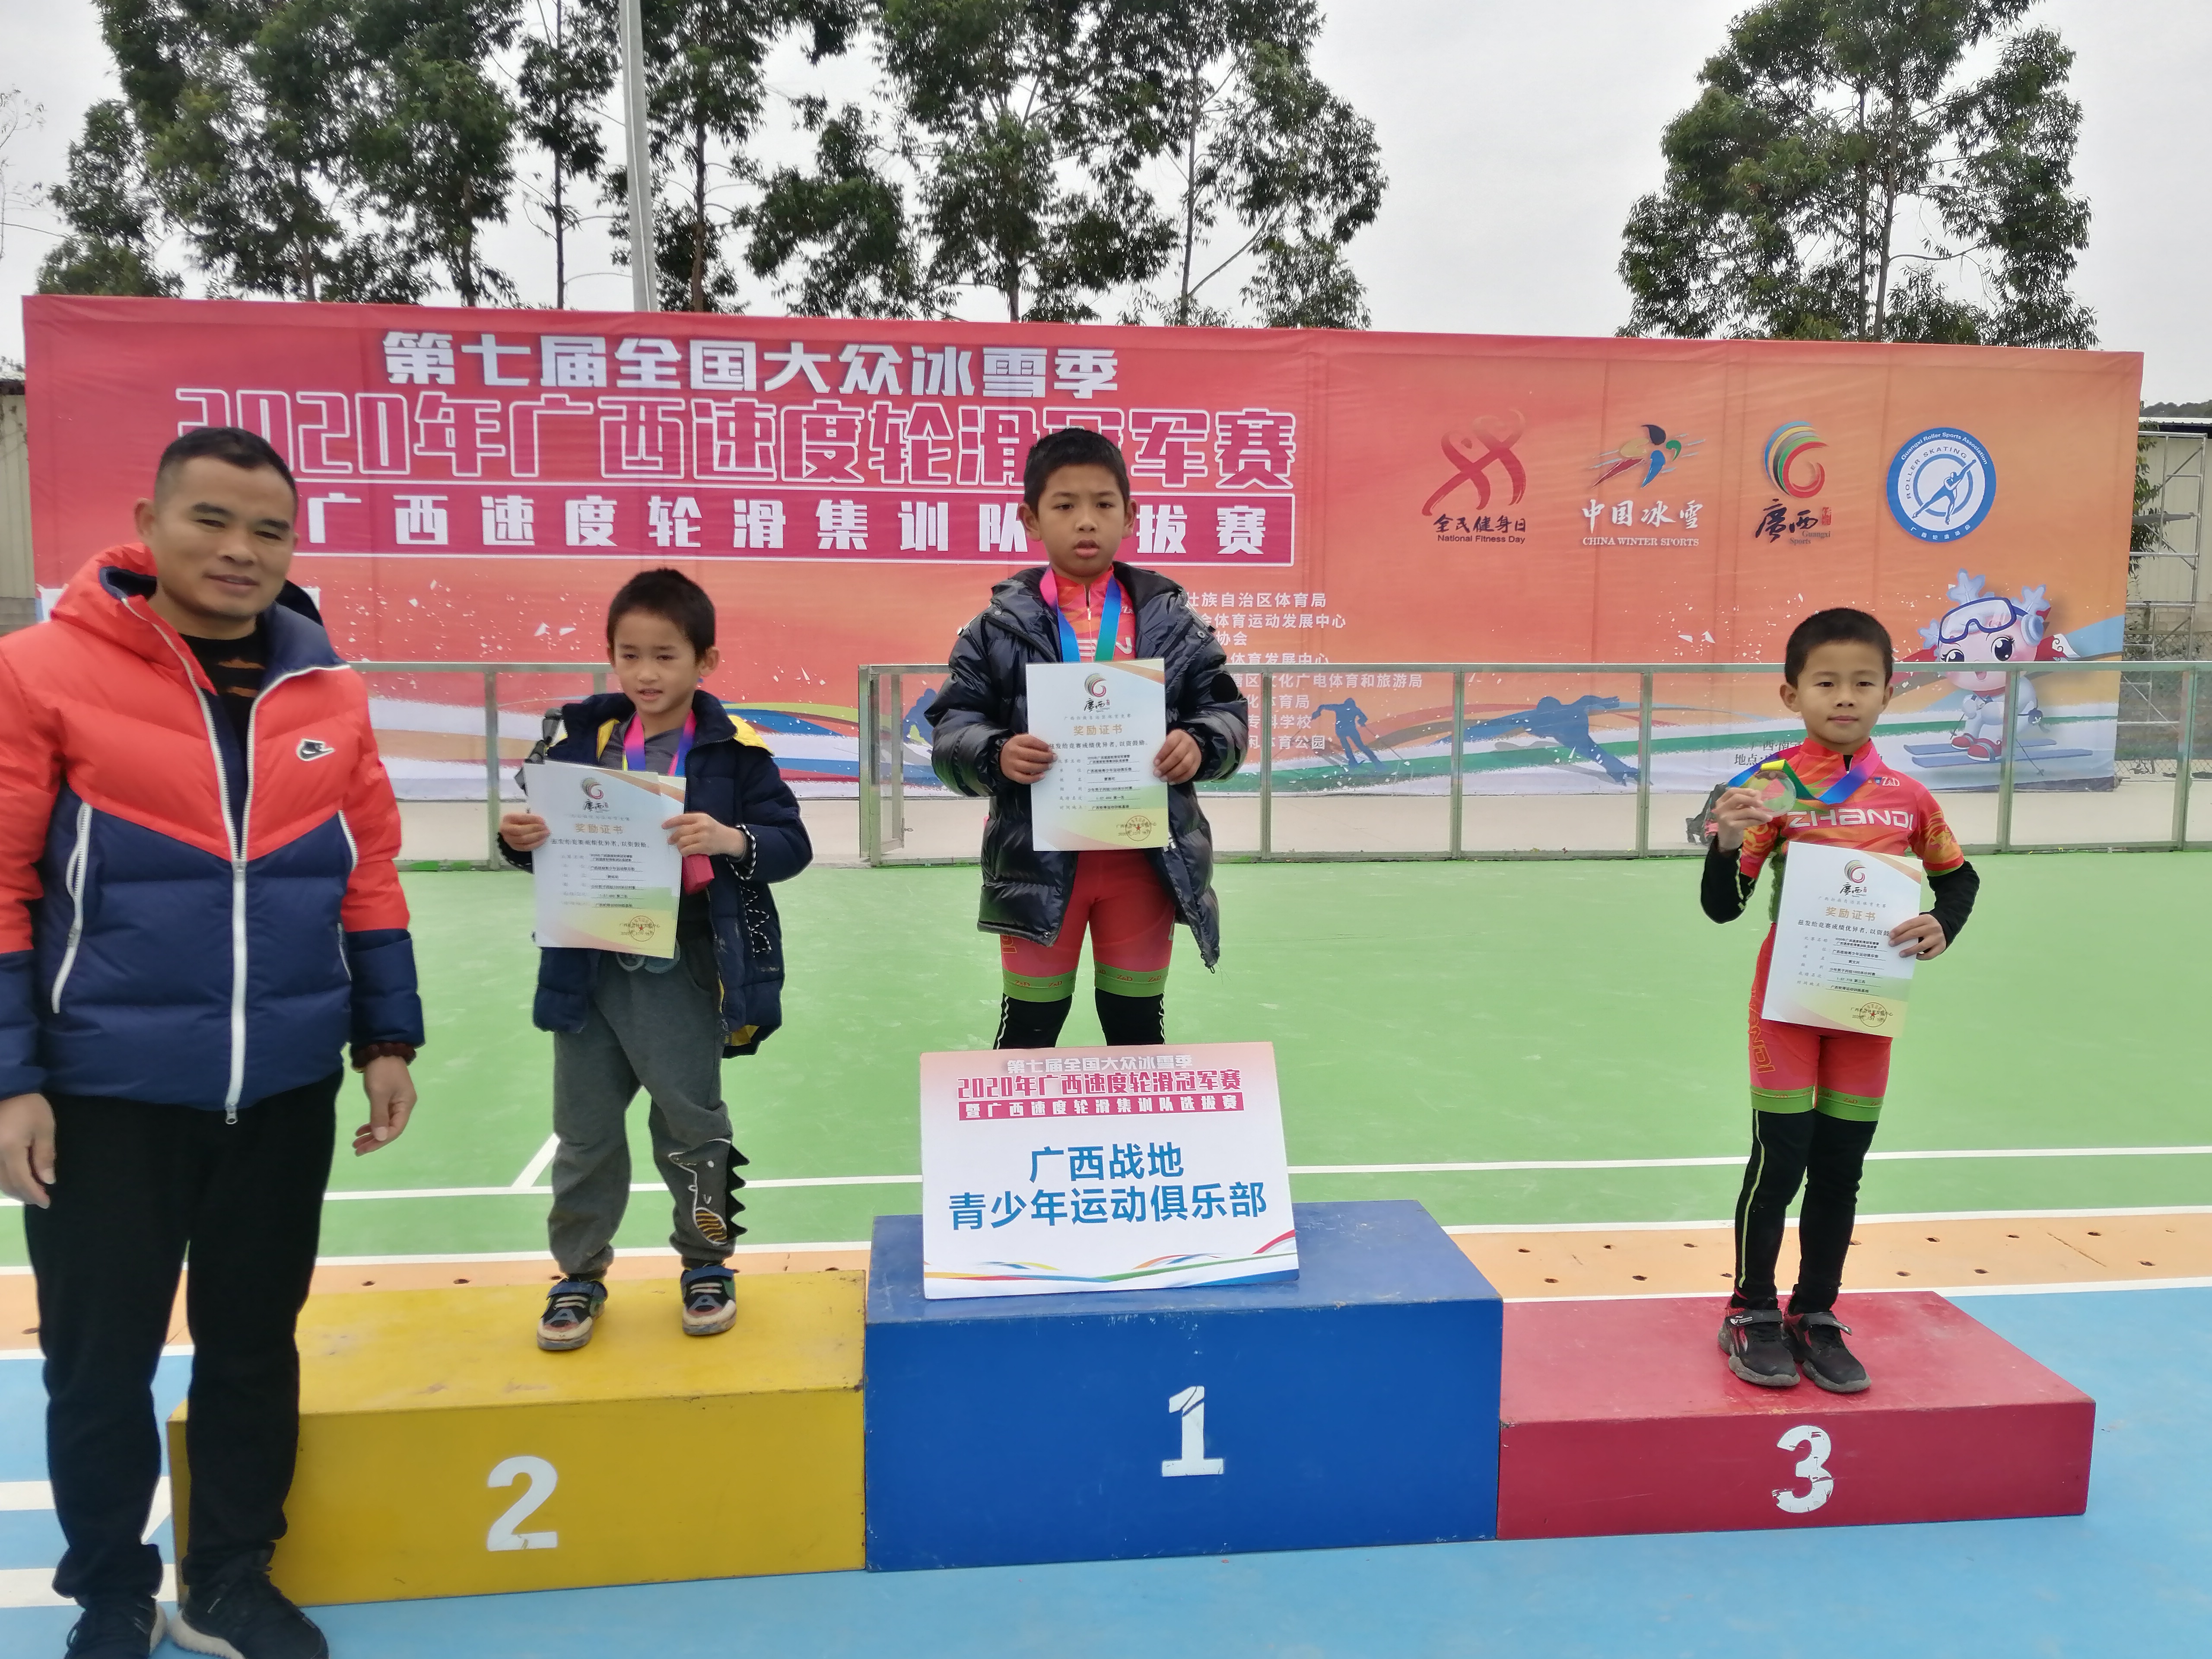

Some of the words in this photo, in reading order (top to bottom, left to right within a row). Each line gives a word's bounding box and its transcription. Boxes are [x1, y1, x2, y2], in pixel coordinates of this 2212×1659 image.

[383, 331, 1118, 399] 第七届全国大众冰雪季
[176, 388, 1297, 490] 2020年广西速度轮滑军赛
[1905, 459, 1920, 499] ROLLER
[1923, 446, 1967, 459] SKATING
[308, 493, 1265, 555] 广西速度轮滑集训队拔赛
[1433, 513, 1526, 533] 全民健身日
[1581, 499, 1703, 534] 中国冰雪
[1508, 536, 1525, 544] Day
[1583, 537, 1615, 546] CHINA
[1617, 537, 1658, 546] WINTER
[1660, 538, 1700, 547] SPORTS
[1073, 724, 1122, 736] 奖励证书
[1882, 777, 1900, 786] Z&D
[575, 823, 623, 834] 奖励证书
[1825, 906, 1876, 922] 奖励证书
[1007, 1054, 1193, 1074] 第七届全国大众冰雪季
[958, 1068, 1242, 1099] 2020年广西速度轮滑冠军赛
[965, 1094, 1238, 1119] 暨广西速度轮滑集训队选拔赛
[1029, 1142, 1185, 1184] 广西战地
[949, 1182, 1267, 1231] 青少年运动俱乐部
[1161, 1385, 1225, 1477] 1
[1771, 1425, 1835, 1513] 3
[486, 1455, 559, 1552] 2
